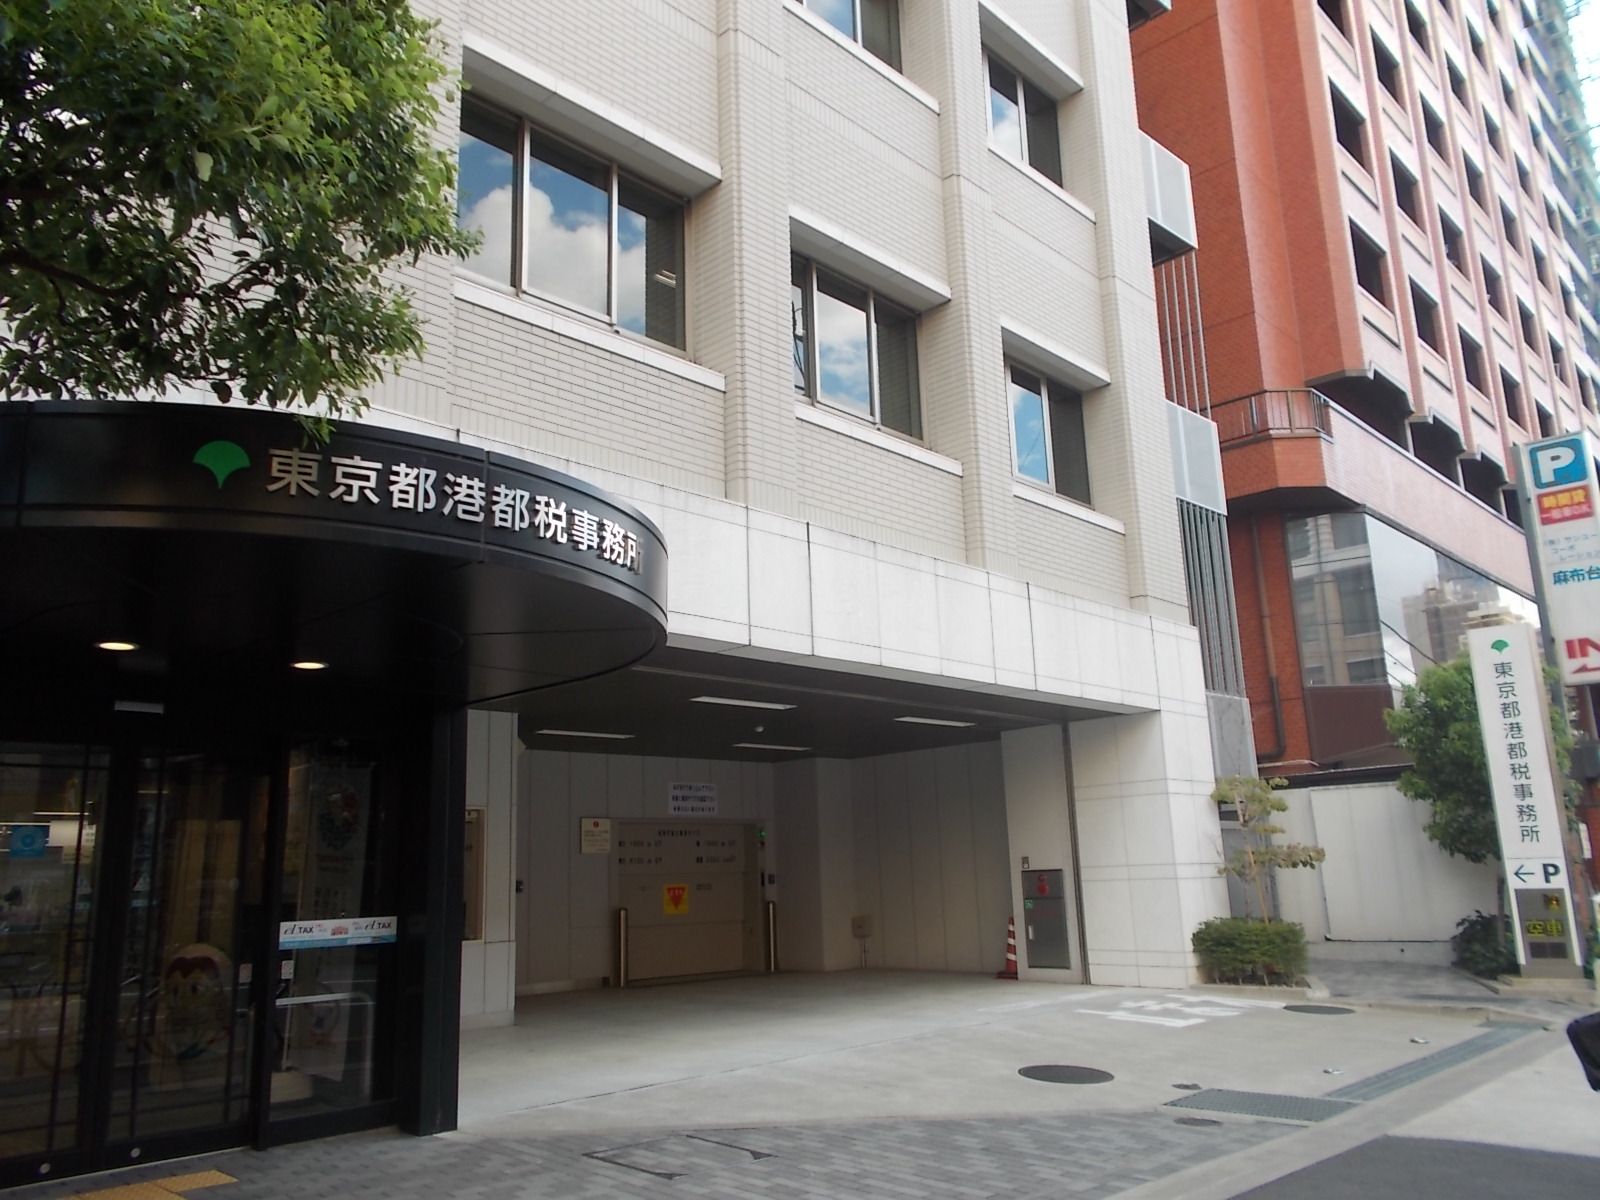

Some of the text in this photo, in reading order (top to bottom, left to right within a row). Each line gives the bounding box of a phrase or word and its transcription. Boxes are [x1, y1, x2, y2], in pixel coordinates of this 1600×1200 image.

[1537, 446, 1575, 484] P
[265, 447, 643, 575] 東京都港都税事務所
[1552, 565, 1600, 585] 麻布台
[1493, 661, 1540, 843] 東京都港都税事務所
[1542, 863, 1561, 884] P
